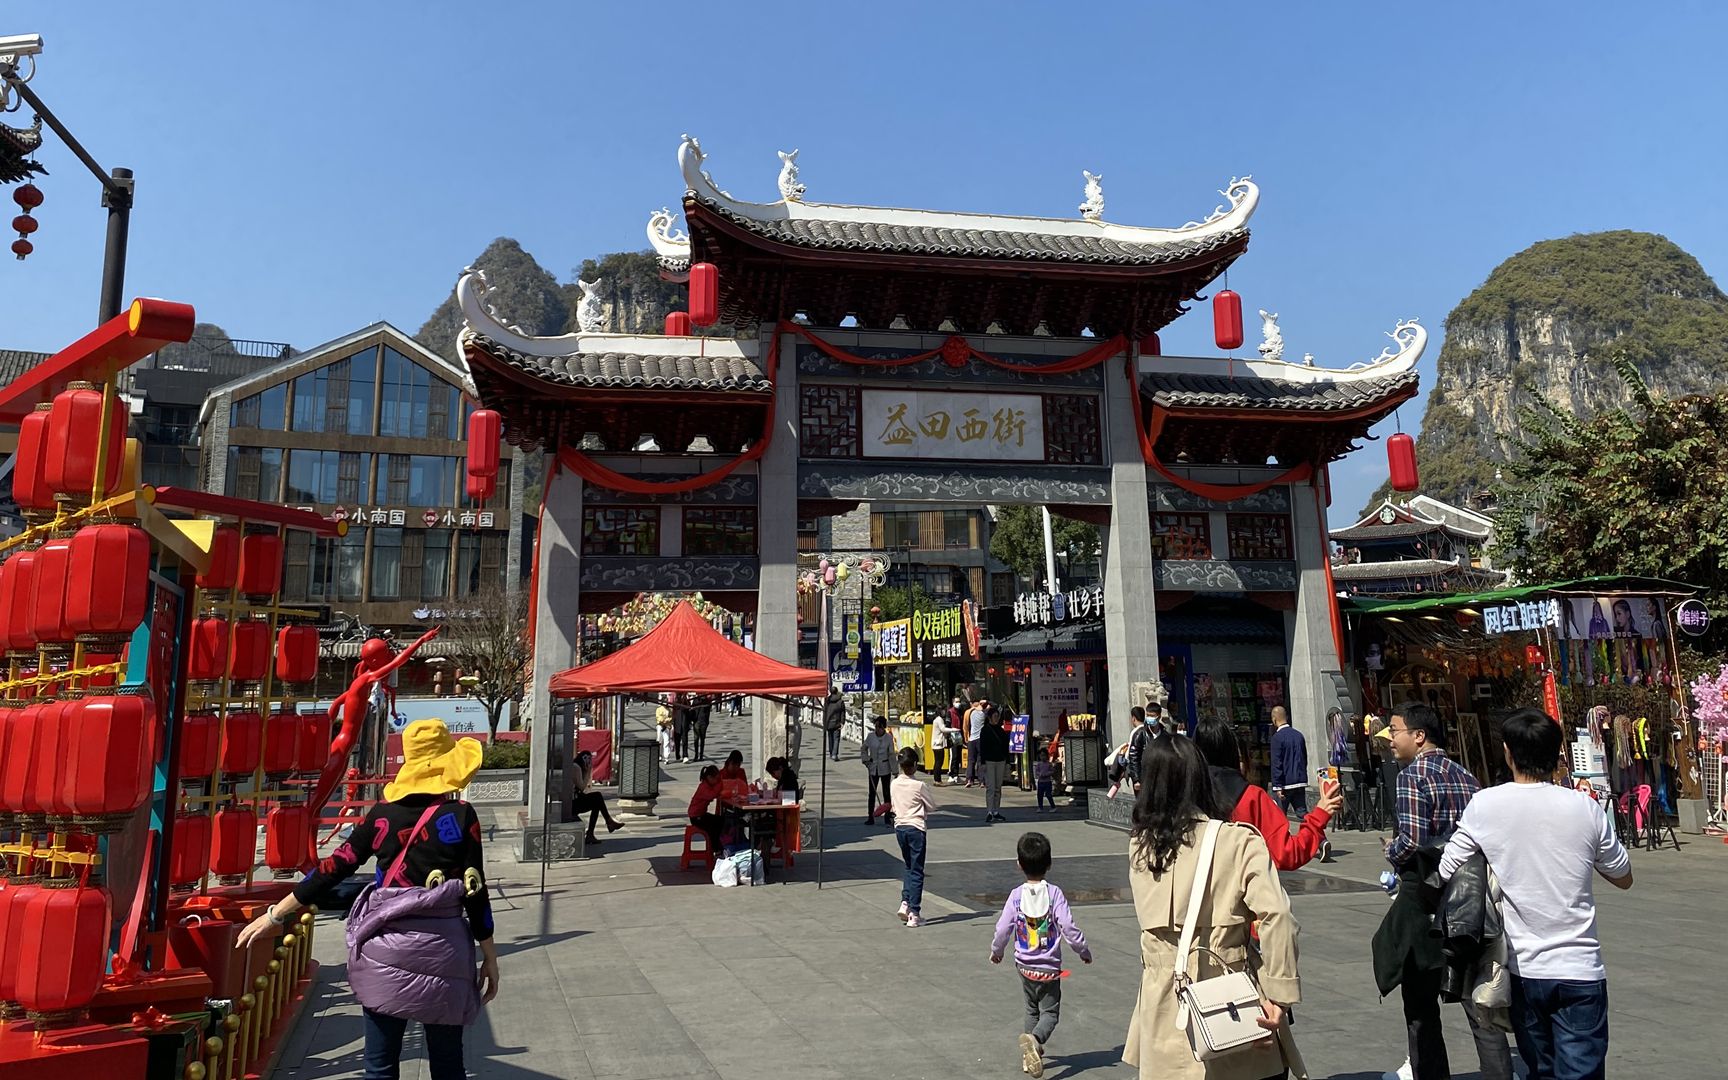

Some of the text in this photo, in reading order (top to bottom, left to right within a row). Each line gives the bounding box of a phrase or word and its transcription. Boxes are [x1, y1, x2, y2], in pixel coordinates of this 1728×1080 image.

[878, 403, 1027, 448] 益田西街
[352, 507, 406, 526] 小南国
[442, 509, 494, 527] 小南国
[922, 606, 961, 641] 又卷烧饼
[1483, 598, 1560, 634] 网红脏辫
